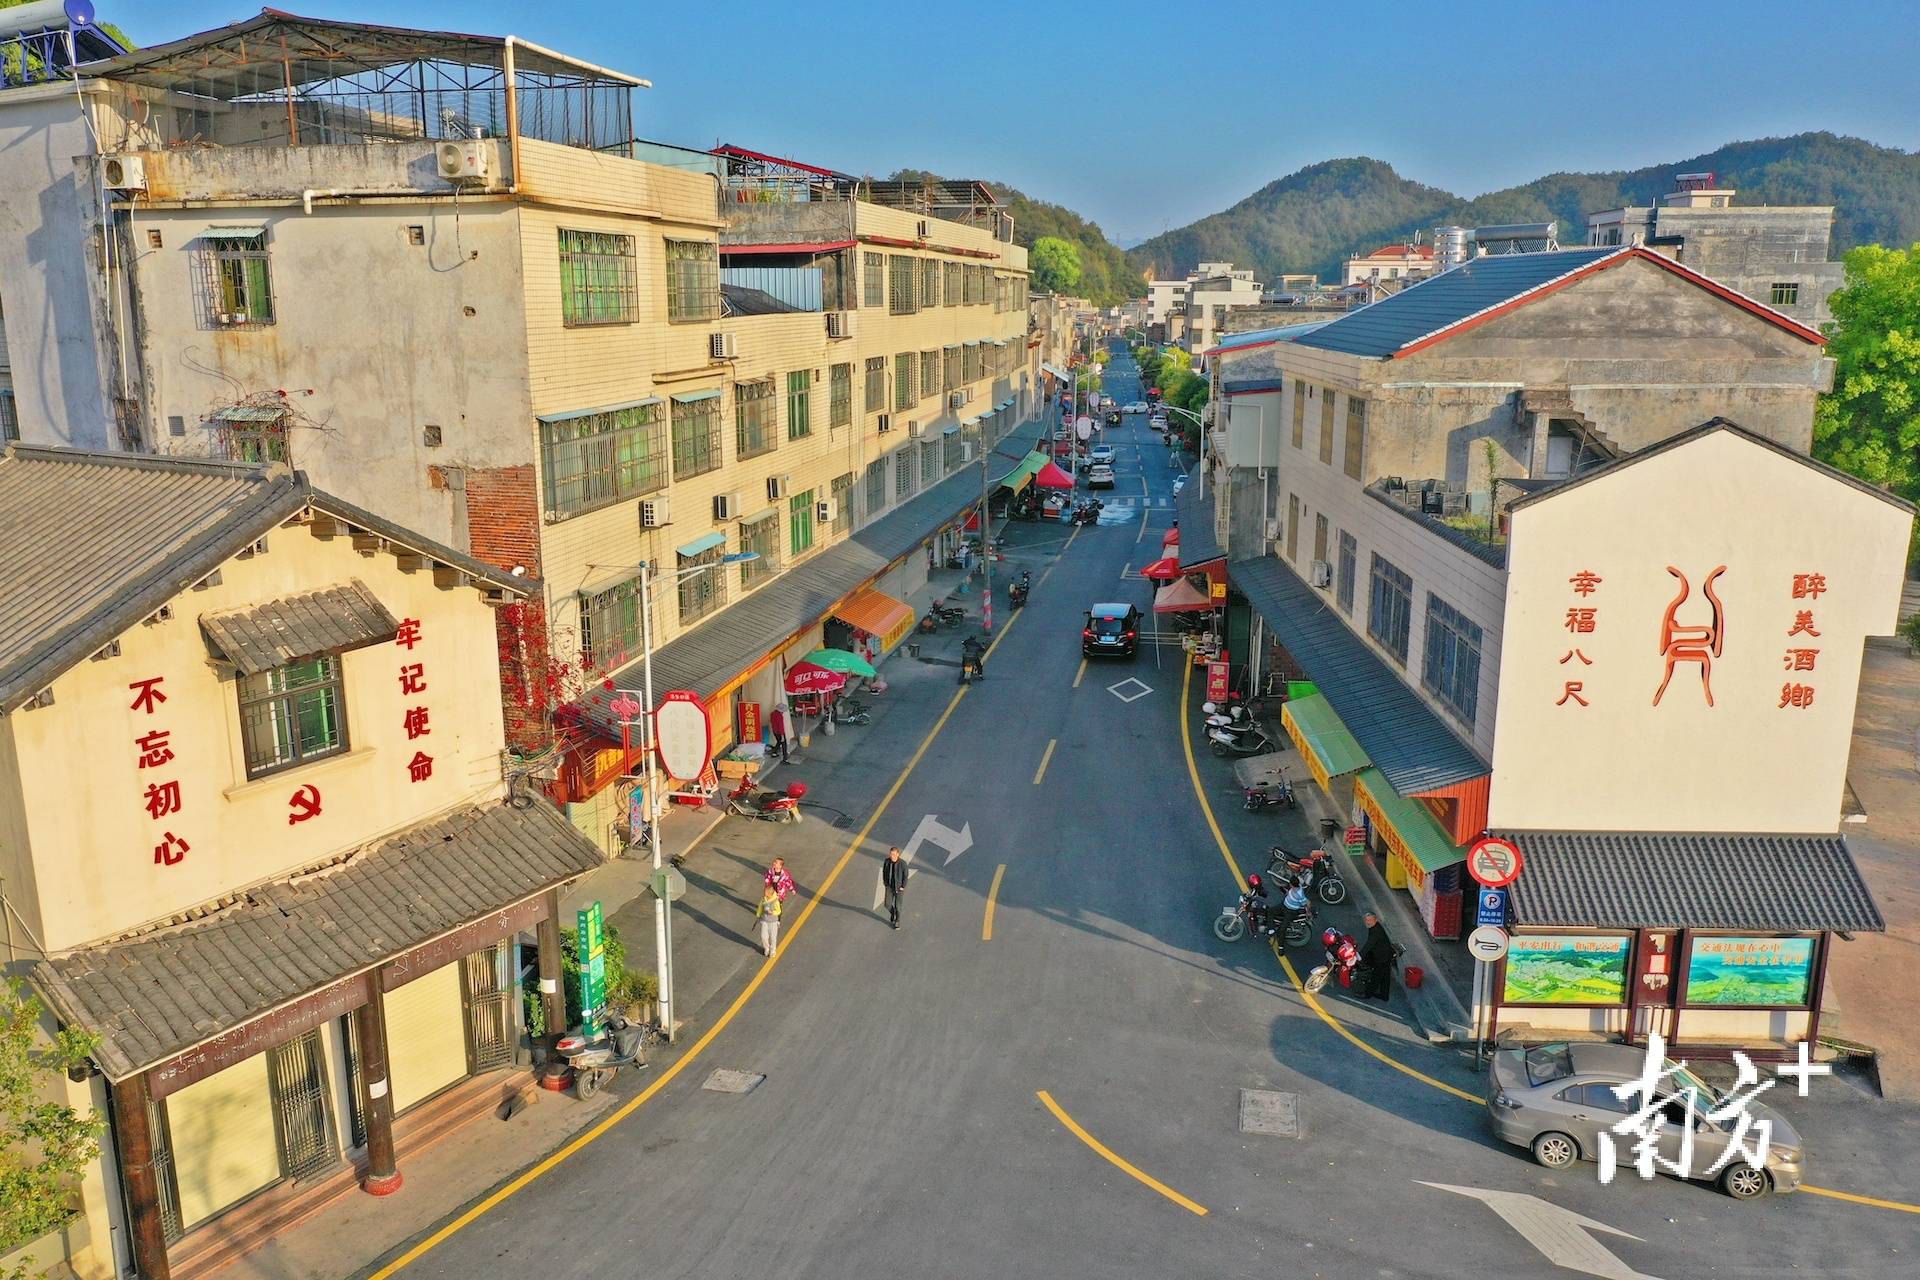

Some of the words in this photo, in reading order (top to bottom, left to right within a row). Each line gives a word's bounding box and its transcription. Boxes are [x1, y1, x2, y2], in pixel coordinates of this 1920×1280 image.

[1212, 583, 1227, 597] 酒
[1555, 569, 1603, 708] 幸福八尺
[794, 670, 830, 686] 可口可乐
[395, 617, 434, 783] 牢记使命
[128, 676, 190, 866] 不忘初心
[1519, 940, 1562, 952] 平安出行
[1574, 941, 1621, 953] 和谐交通
[1700, 942, 1783, 954] 交通法规在心中
